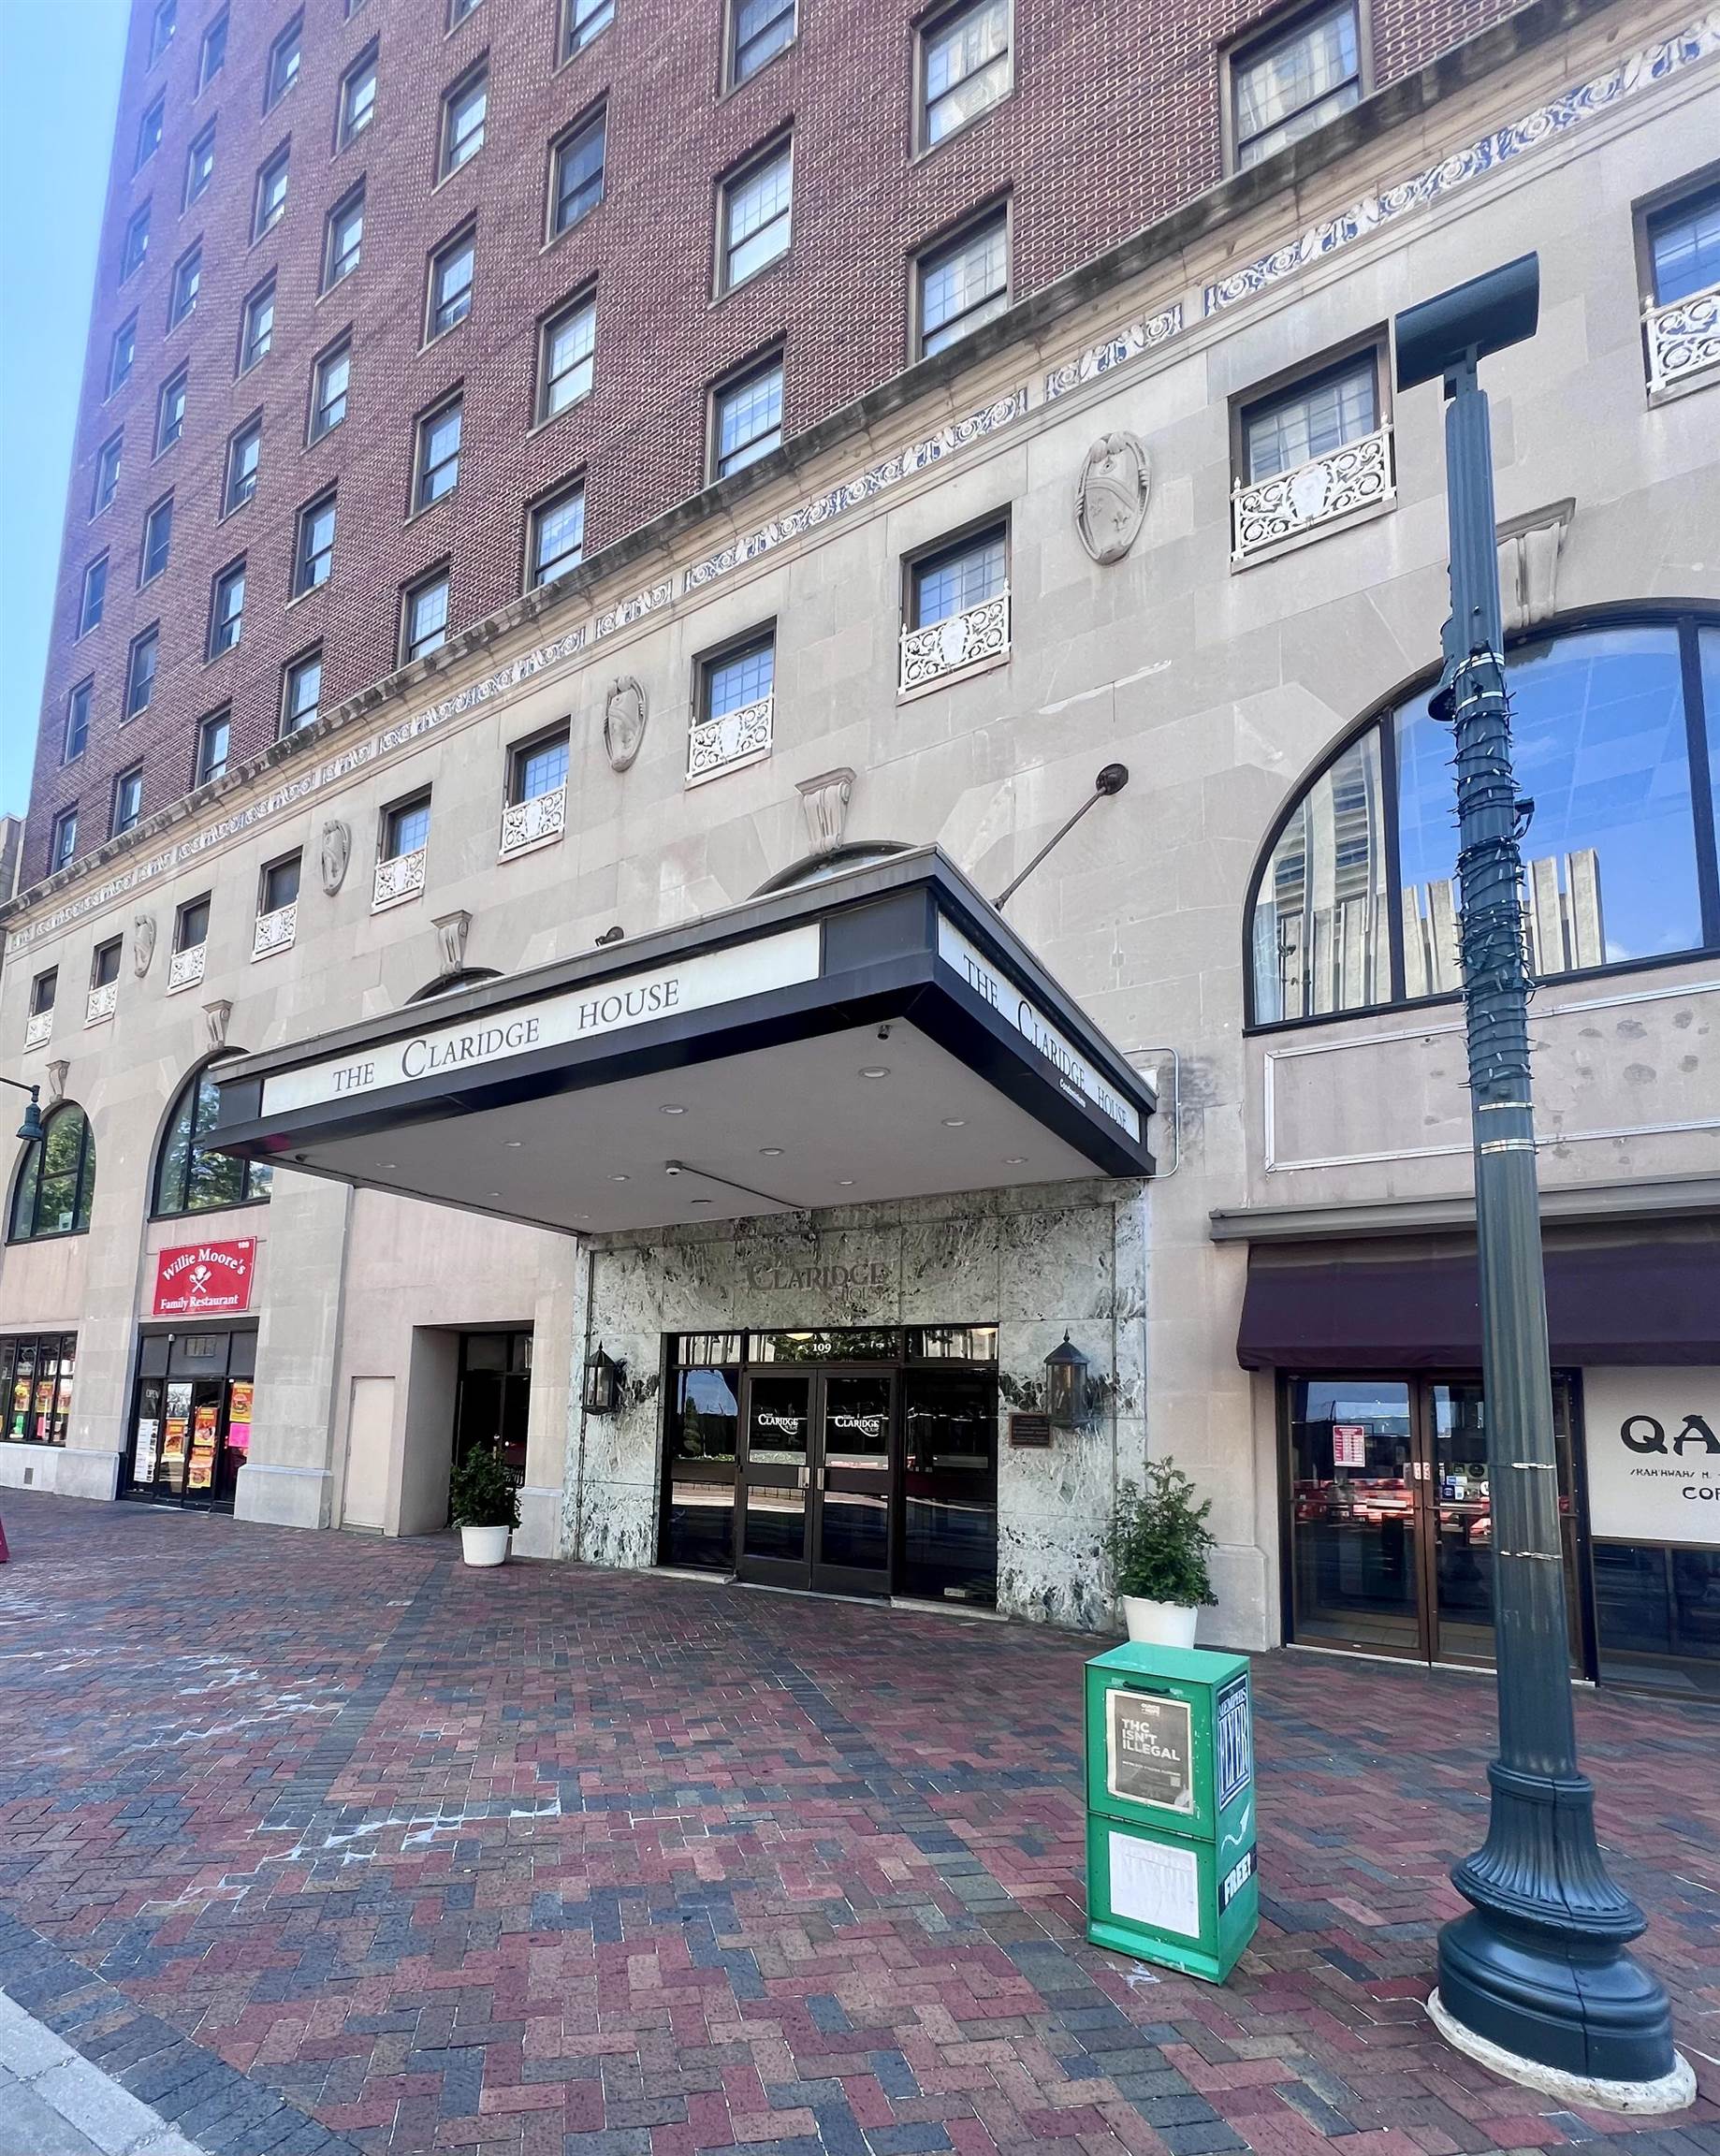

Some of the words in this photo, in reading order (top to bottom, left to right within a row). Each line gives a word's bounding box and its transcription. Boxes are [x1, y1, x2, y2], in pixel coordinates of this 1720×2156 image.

[333, 1062, 374, 1093] THE
[401, 1018, 540, 1078] CLARIDGE
[578, 979, 680, 1030] HOUSE
[964, 954, 998, 1011] THE
[1018, 999, 1086, 1092] CLARIDGE
[1096, 1085, 1127, 1129] HOUSE
[163, 1254, 196, 1281] Willie
[197, 1248, 245, 1275] Moore's
[748, 1258, 885, 1290] CLARIDGE
[160, 1297, 188, 1311] Family
[189, 1294, 240, 1308] Restaurant
[812, 1343, 832, 1353] 109
[758, 1413, 798, 1426] CLARIDGE
[835, 1415, 880, 1428] CLARIDGE
[1121, 1718, 1150, 1733] THC
[1121, 1729, 1158, 1745] ISN'T
[1122, 1740, 1181, 1761] ILLEGAL
